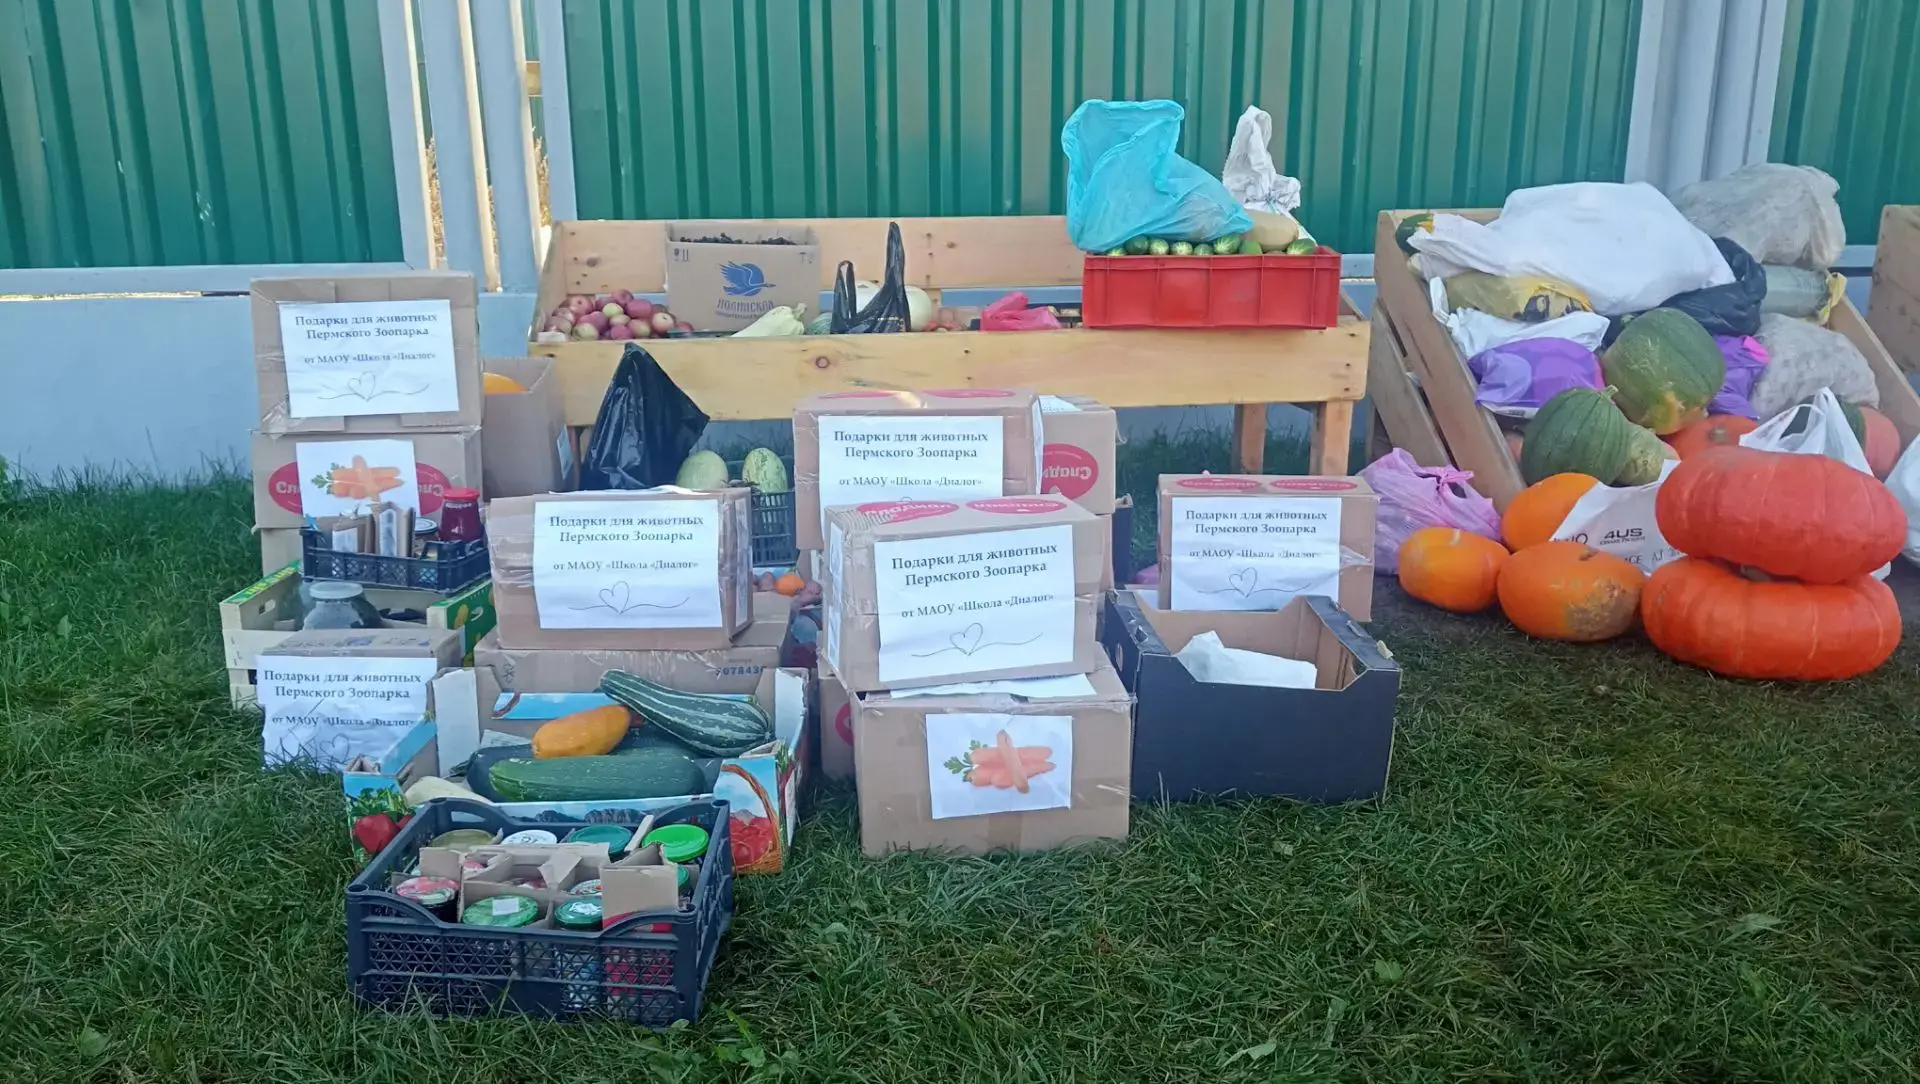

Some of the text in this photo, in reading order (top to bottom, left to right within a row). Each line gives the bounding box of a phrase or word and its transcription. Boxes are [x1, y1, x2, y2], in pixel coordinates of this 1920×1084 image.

[295, 314, 437, 328] Подарки для животных
[307, 327, 429, 342] Пермского Зоопарка
[317, 354, 349, 364] МАОУ
[833, 431, 988, 444] Подарки для животных
[845, 447, 978, 460] Пермского Зоопарка
[853, 476, 888, 487] МАОУ
[1186, 510, 1328, 522] Подарки для животных
[550, 516, 704, 531] Подарки для животных
[1195, 523, 1317, 535] Пермского Зоопарка
[560, 531, 693, 544] Пермского Зоопарка
[1604, 528, 1643, 539] 4US
[892, 544, 1058, 573] Подарки для животных
[1201, 549, 1233, 559] МАОУ
[553, 562, 565, 570] от
[567, 561, 602, 572] МАОУ
[905, 562, 1047, 587] Пермского Зоопарка
[901, 610, 914, 618] от
[917, 603, 955, 617] МАОУ
[264, 670, 421, 684] Подарки для животных
[275, 686, 410, 701] Пермского Зоопарка
[272, 717, 284, 725] от
[286, 716, 319, 727] МАОУ
